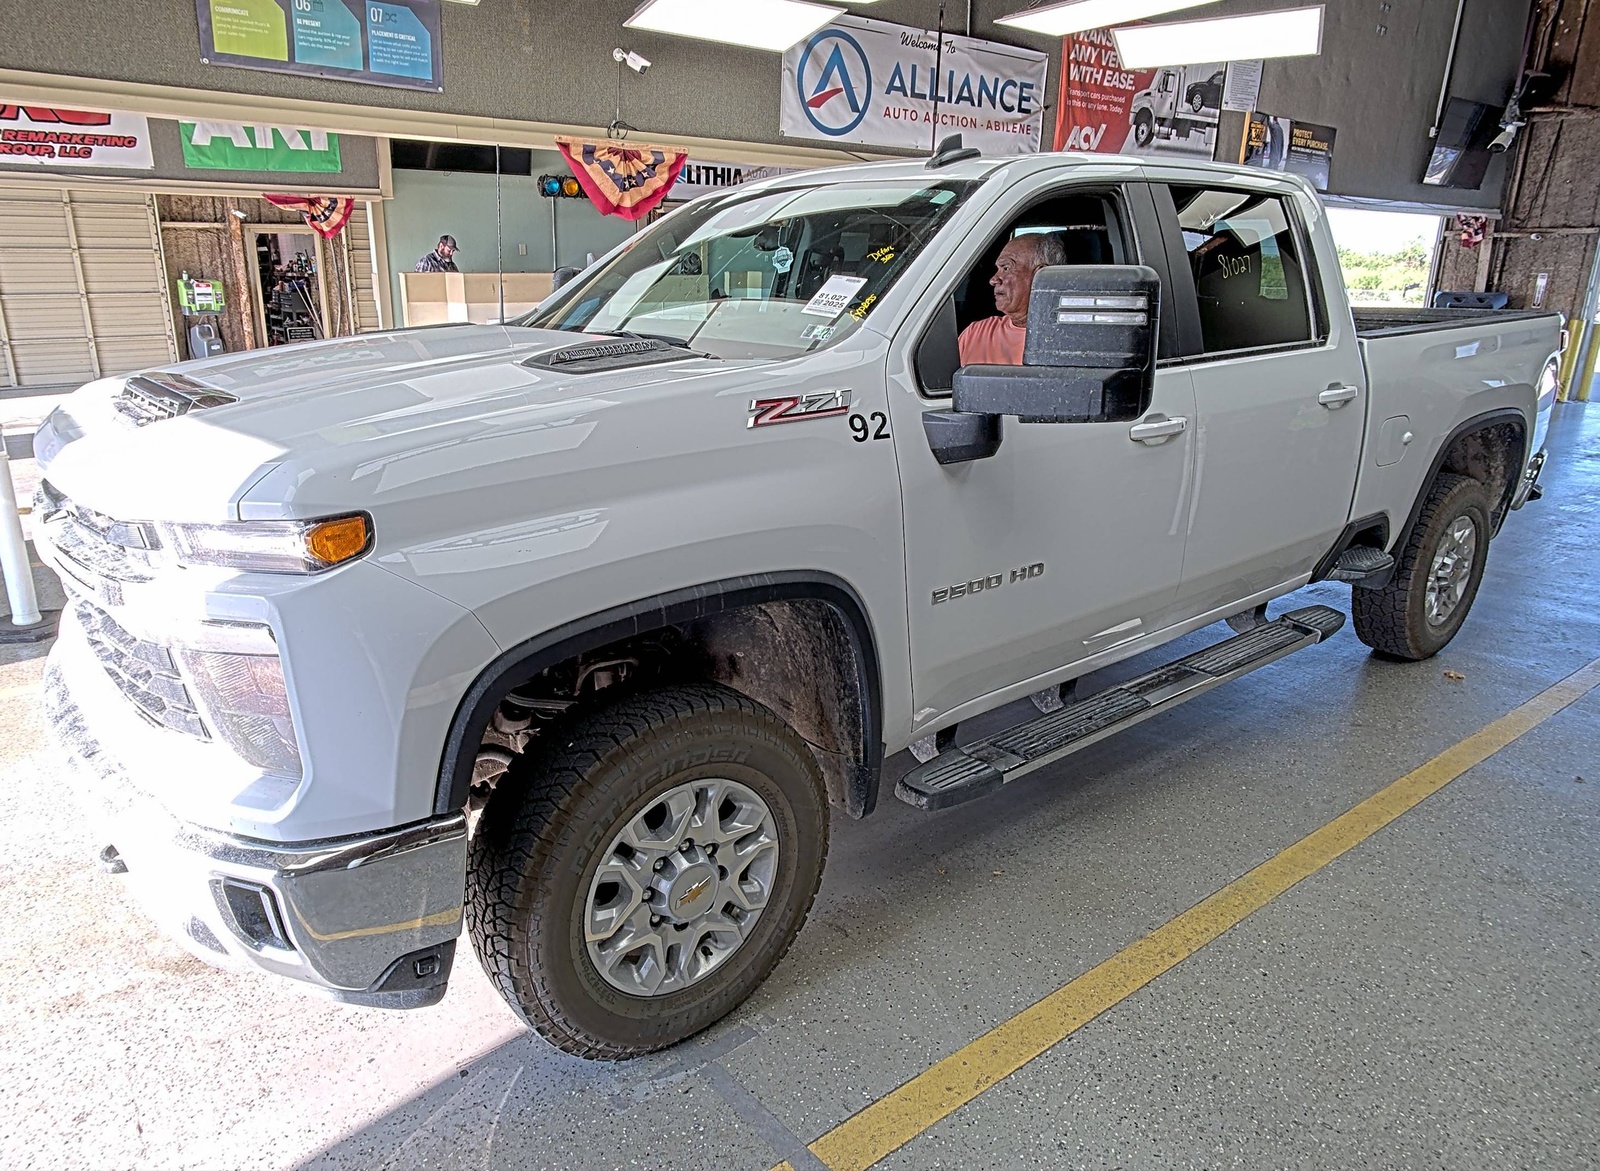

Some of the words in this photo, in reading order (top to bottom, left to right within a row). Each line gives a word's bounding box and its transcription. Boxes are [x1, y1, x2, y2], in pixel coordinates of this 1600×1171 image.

[215, 5, 249, 16] COMMUNICATE
[295, 0, 311, 12] 06
[370, 7, 383, 23] 07
[302, 18, 321, 27] PRESENT
[371, 29, 394, 39] PLACEMENT
[398, 33, 416, 42] CRITICAL
[1073, 28, 1115, 48] TRANS
[944, 40, 956, 54] To
[1069, 43, 1100, 64] ANY
[1069, 62, 1103, 85] WITH
[1103, 70, 1136, 91] EASE.
[884, 61, 1034, 115] ALLIANCE
[1068, 87, 1090, 98] Transport
[1090, 90, 1101, 100] cars
[1101, 92, 1126, 103] purchased
[1071, 98, 1081, 107] this
[1096, 103, 1109, 112] lane.
[1109, 104, 1124, 115] Today.
[883, 106, 918, 122] AUTO
[923, 111, 977, 129] AUCTION
[986, 119, 1032, 135] ABILENE
[2, 129, 137, 148] REMARKETING
[1062, 123, 1107, 152] ACV
[1293, 128, 1313, 139] PROTECT
[58, 145, 93, 159] LLC
[1292, 137, 1307, 147] EVERY
[1306, 139, 1329, 151] PURCHASE.
[686, 164, 744, 187] LITHIA
[746, 169, 768, 179] AUTO
[1217, 254, 1252, 279] 81027
[746, 388, 852, 429] Z71
[848, 411, 891, 443] 92
[931, 572, 1003, 606] 2500
[1009, 562, 1045, 584] HD
